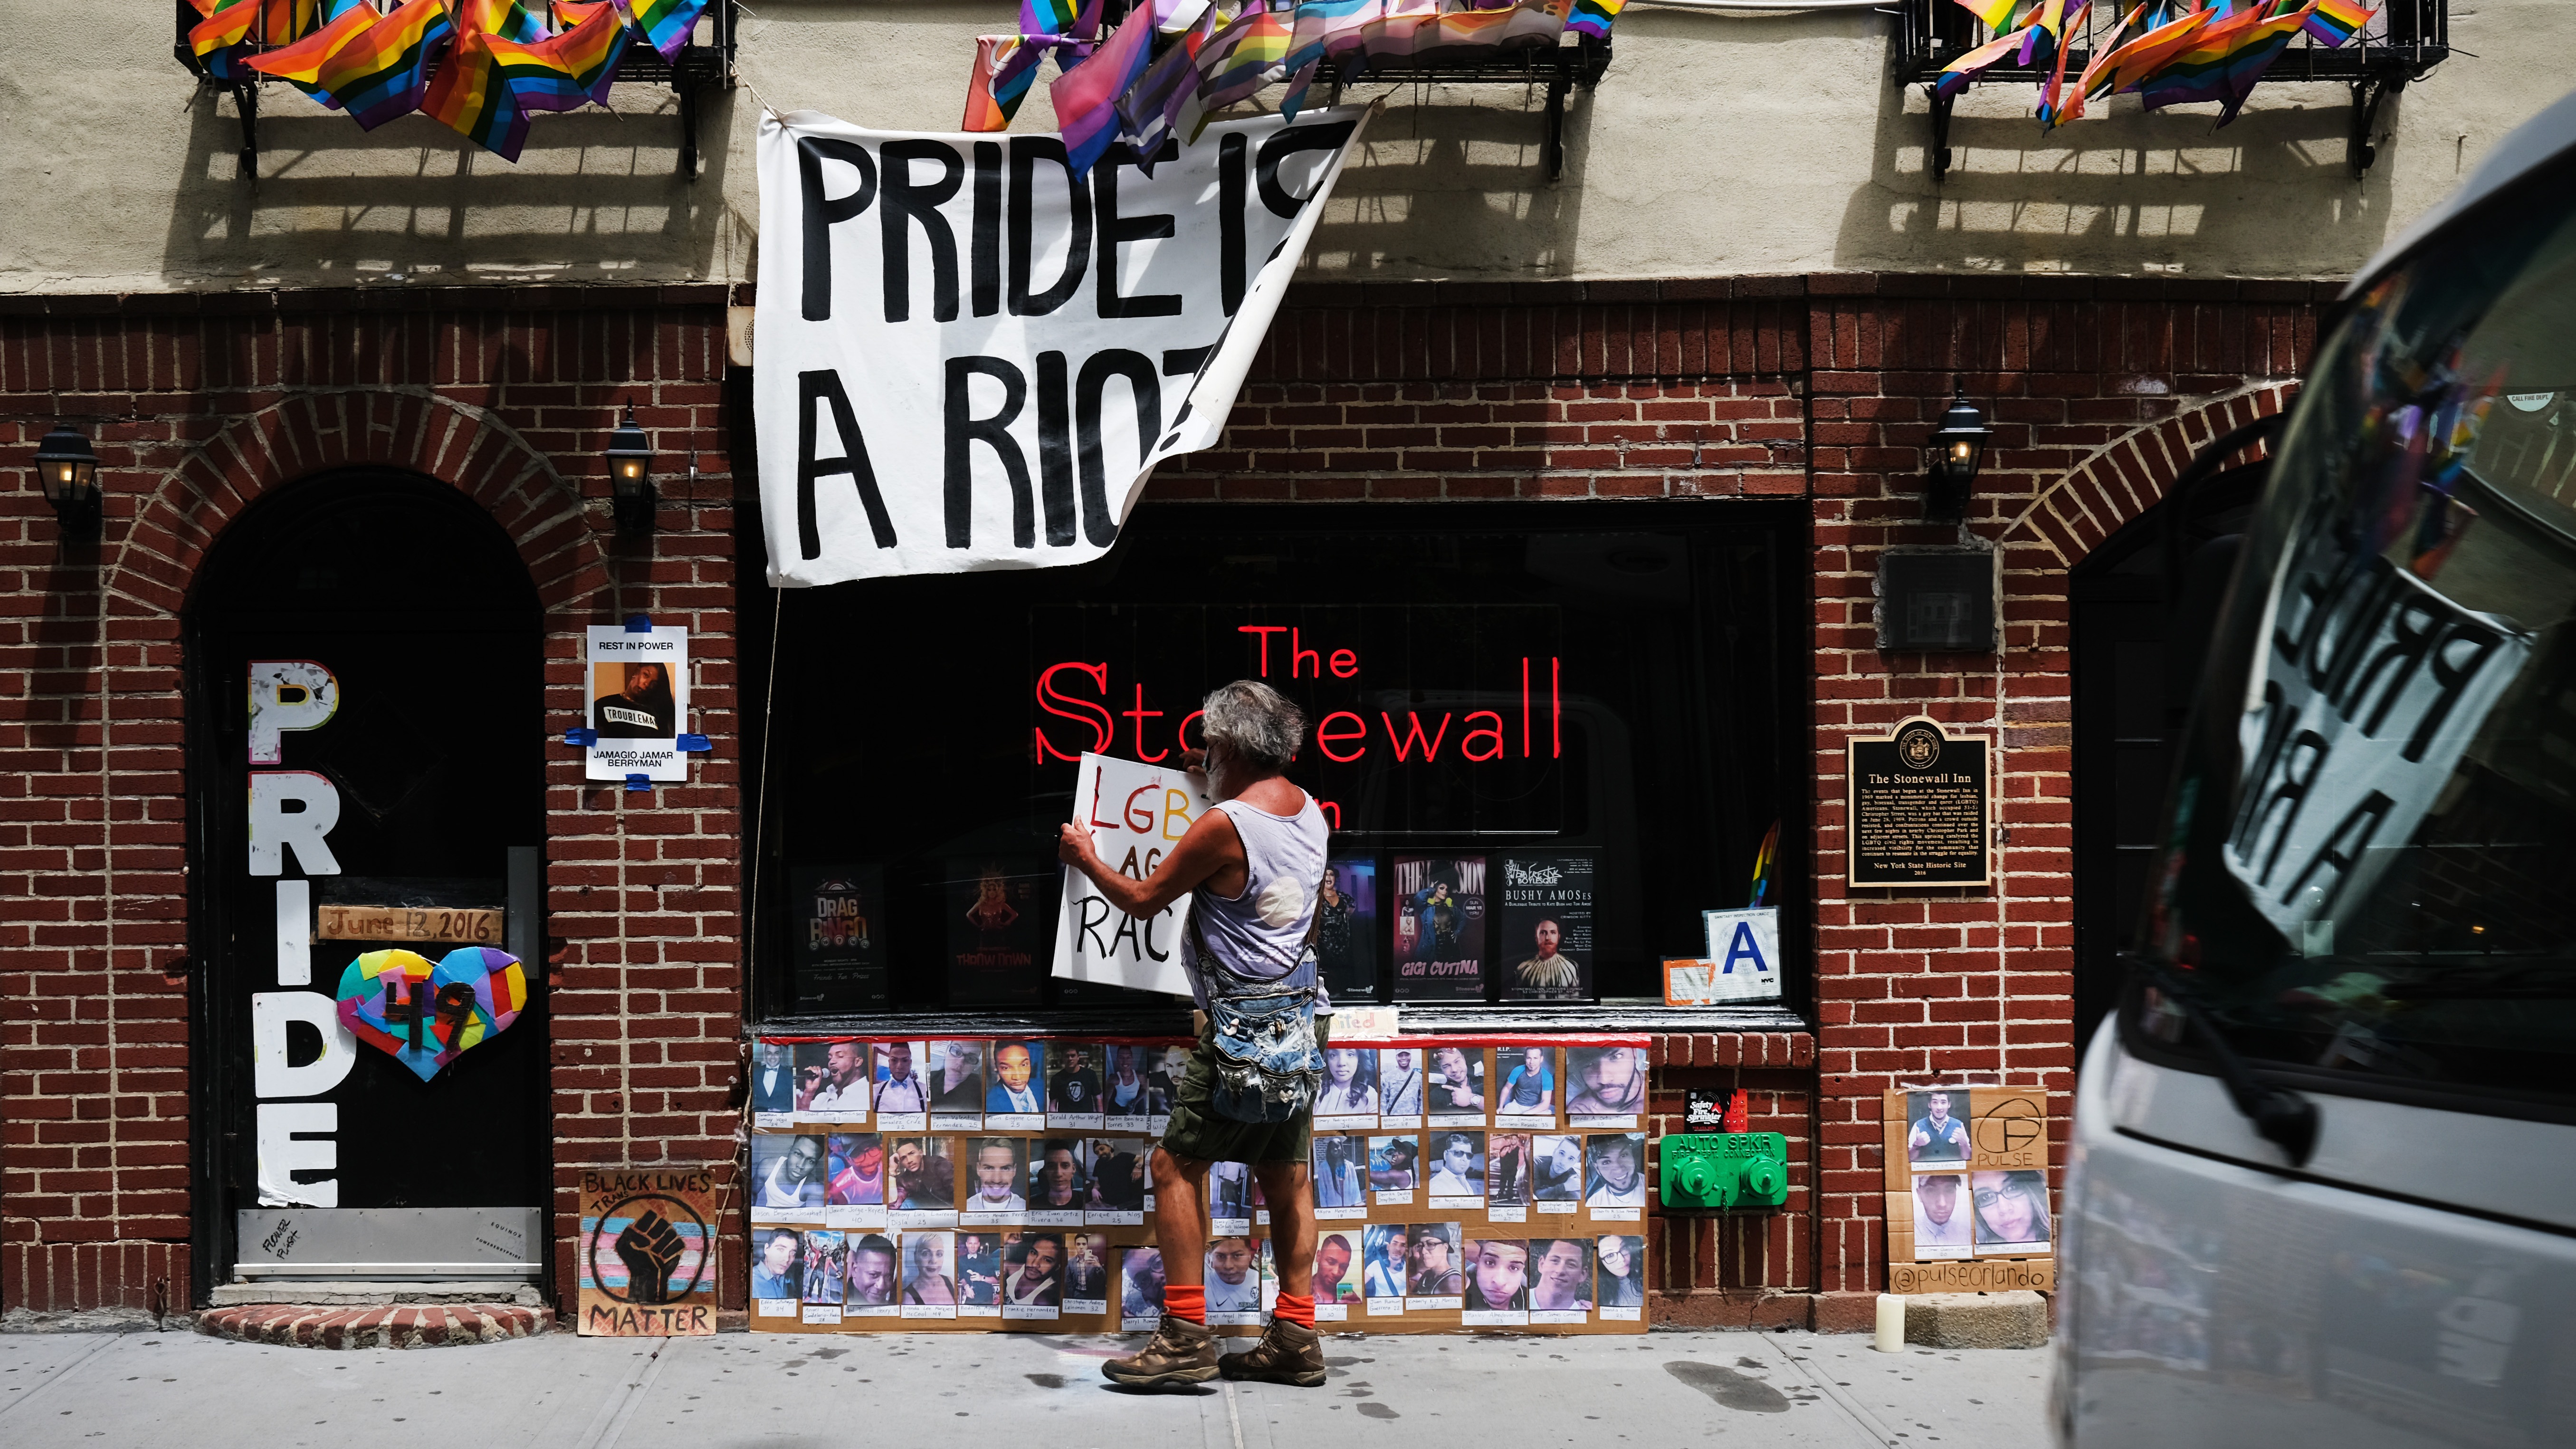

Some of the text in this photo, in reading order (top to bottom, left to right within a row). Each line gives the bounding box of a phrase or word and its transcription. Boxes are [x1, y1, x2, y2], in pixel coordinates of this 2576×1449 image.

[797, 135, 1183, 323] PRIDE
[797, 369, 898, 560] A
[599, 642, 674, 650] REST IN POWER
[1237, 625, 1360, 679] The
[1034, 656, 1562, 765] Stewall
[593, 751, 637, 759] JAMAGIO
[608, 759, 662, 767] BERRYMAN
[1868, 773, 1971, 784] The Stonewall Inn
[1394, 860, 1425, 896] THE
[1506, 890, 1543, 900] BUSHY
[817, 896, 858, 918] DRAG
[327, 909, 394, 935] June
[810, 916, 867, 942] BINGO
[248, 660, 357, 1208] PRIDE
[1722, 921, 1768, 974] A
[385, 981, 477, 1054] 49
[1689, 1100, 1713, 1110] Safety
[1679, 1134, 1772, 1151] AUTO SPKR
[1671, 1150, 1690, 1160] FIRE
[1723, 1148, 1775, 1159] CONNECTION
[1977, 1152, 2034, 1167] PULSE
[585, 1172, 712, 1193] BLACK LIVES
[590, 1190, 630, 1212] TRANS
[491, 1221, 522, 1238] EQUINOX
[1894, 1264, 2044, 1292] @pulseorlando
[589, 1304, 708, 1334] MATTER
